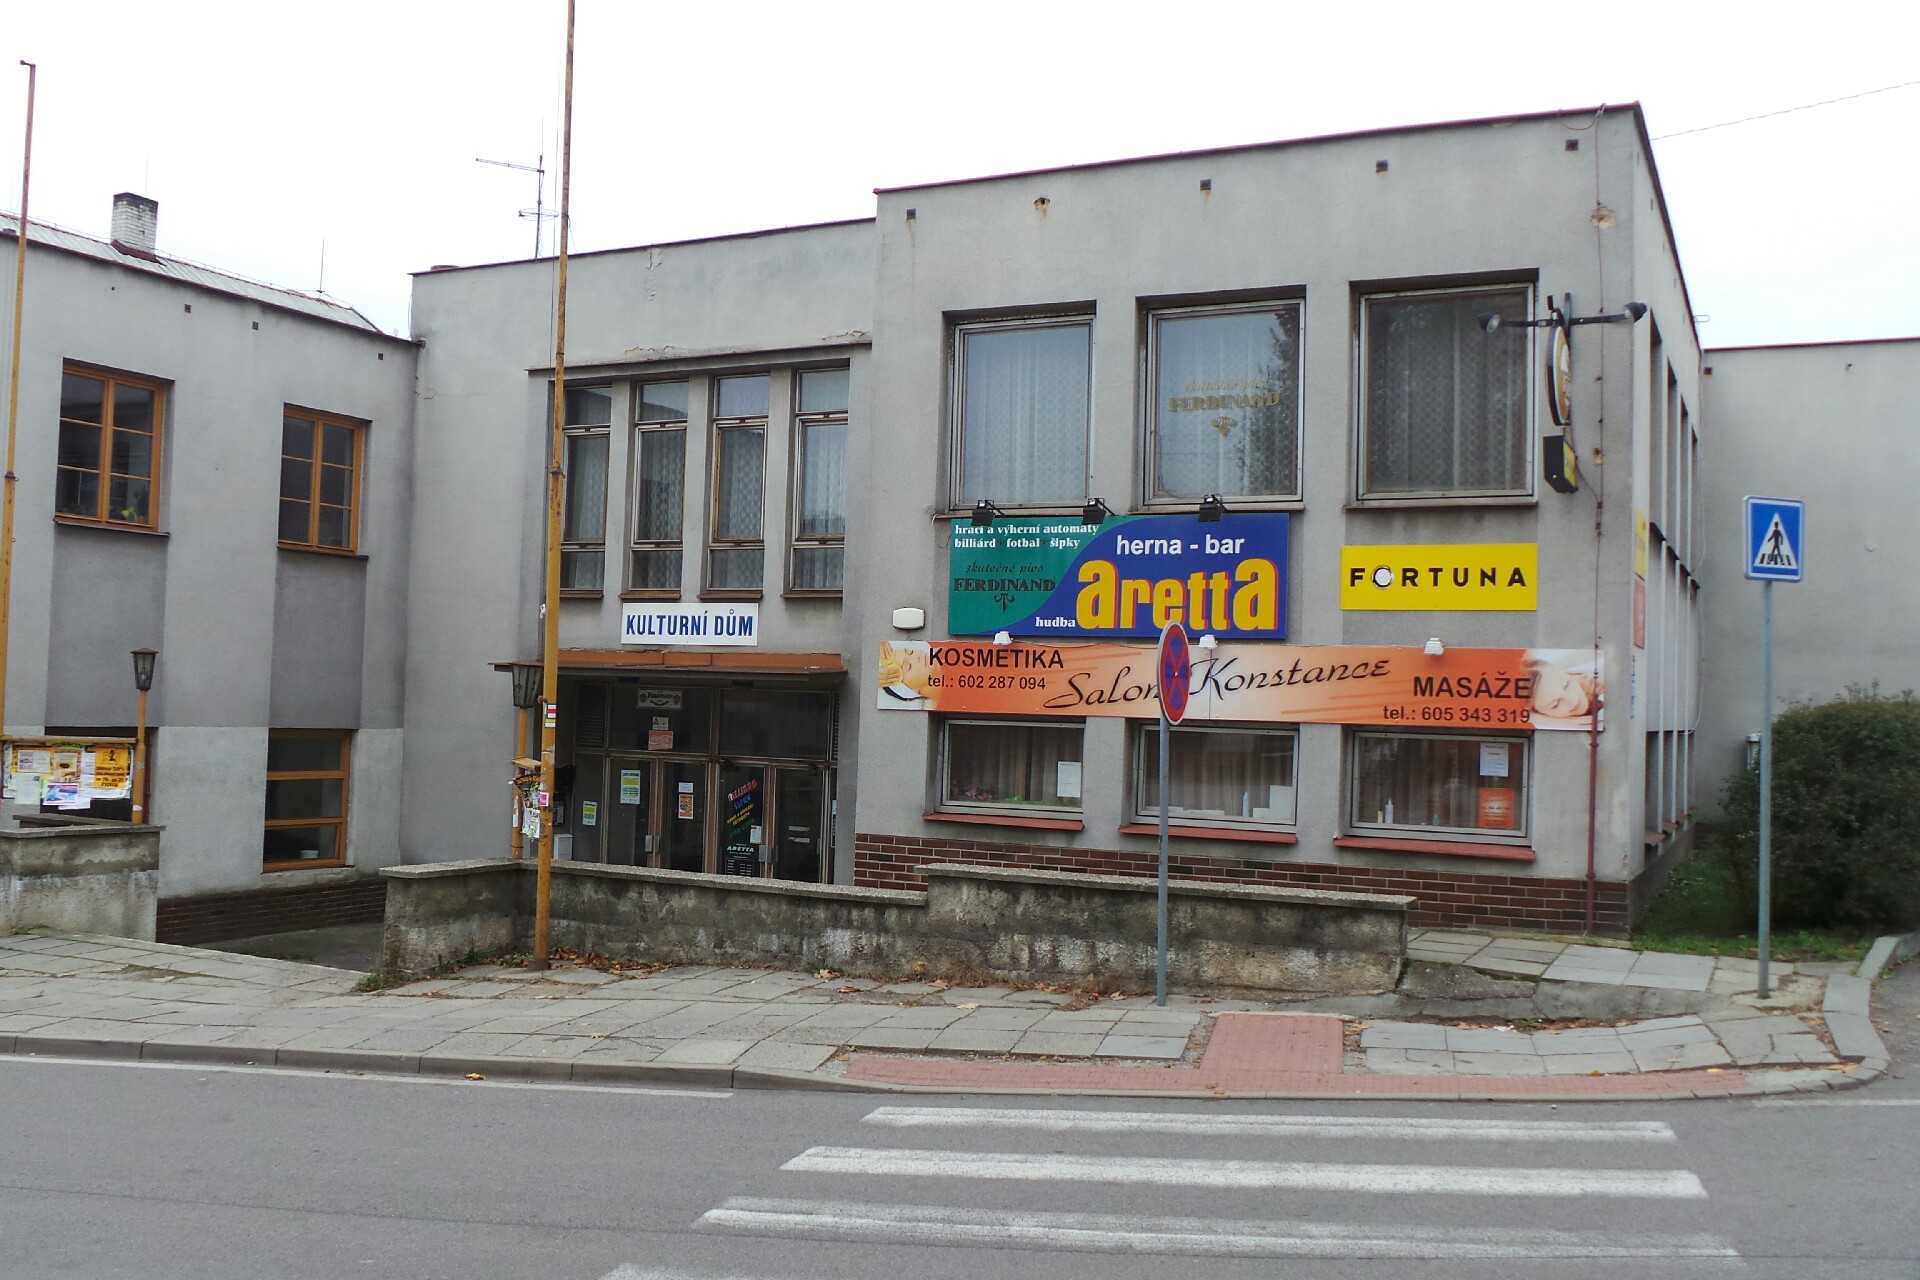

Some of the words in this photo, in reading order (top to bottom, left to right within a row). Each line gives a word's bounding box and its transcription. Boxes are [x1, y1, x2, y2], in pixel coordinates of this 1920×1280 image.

[1168, 390, 1281, 412] FERDINAND
[986, 526, 994, 534] a
[998, 524, 1040, 536] výherní
[1043, 524, 1099, 535] automaty
[954, 538, 996, 548] billiárd
[1006, 538, 1040, 548] fotbal
[1049, 537, 1080, 549] šipky
[1116, 535, 1182, 555] herna
[1205, 534, 1245, 555] bar
[1019, 562, 1044, 575] pivo
[1350, 566, 1527, 588] FORTUNA
[953, 578, 1057, 592] FERDINAND
[1076, 558, 1279, 632] aretta
[626, 611, 708, 636] KULTURNÍ
[714, 608, 754, 637] DŮM
[1035, 616, 1076, 629] hudba
[929, 648, 1064, 669] KOSMETIKA
[928, 674, 955, 689] tel.:
[958, 675, 985, 689] 602
[988, 675, 1015, 690] 287
[1019, 676, 1046, 690] 094
[1189, 657, 1391, 701] Konstance
[1413, 672, 1531, 699] MASÁŽE
[1383, 705, 1416, 720] tel.:
[1421, 706, 1454, 721] 605
[1459, 707, 1492, 722] 343
[1497, 708, 1531, 723] 319
